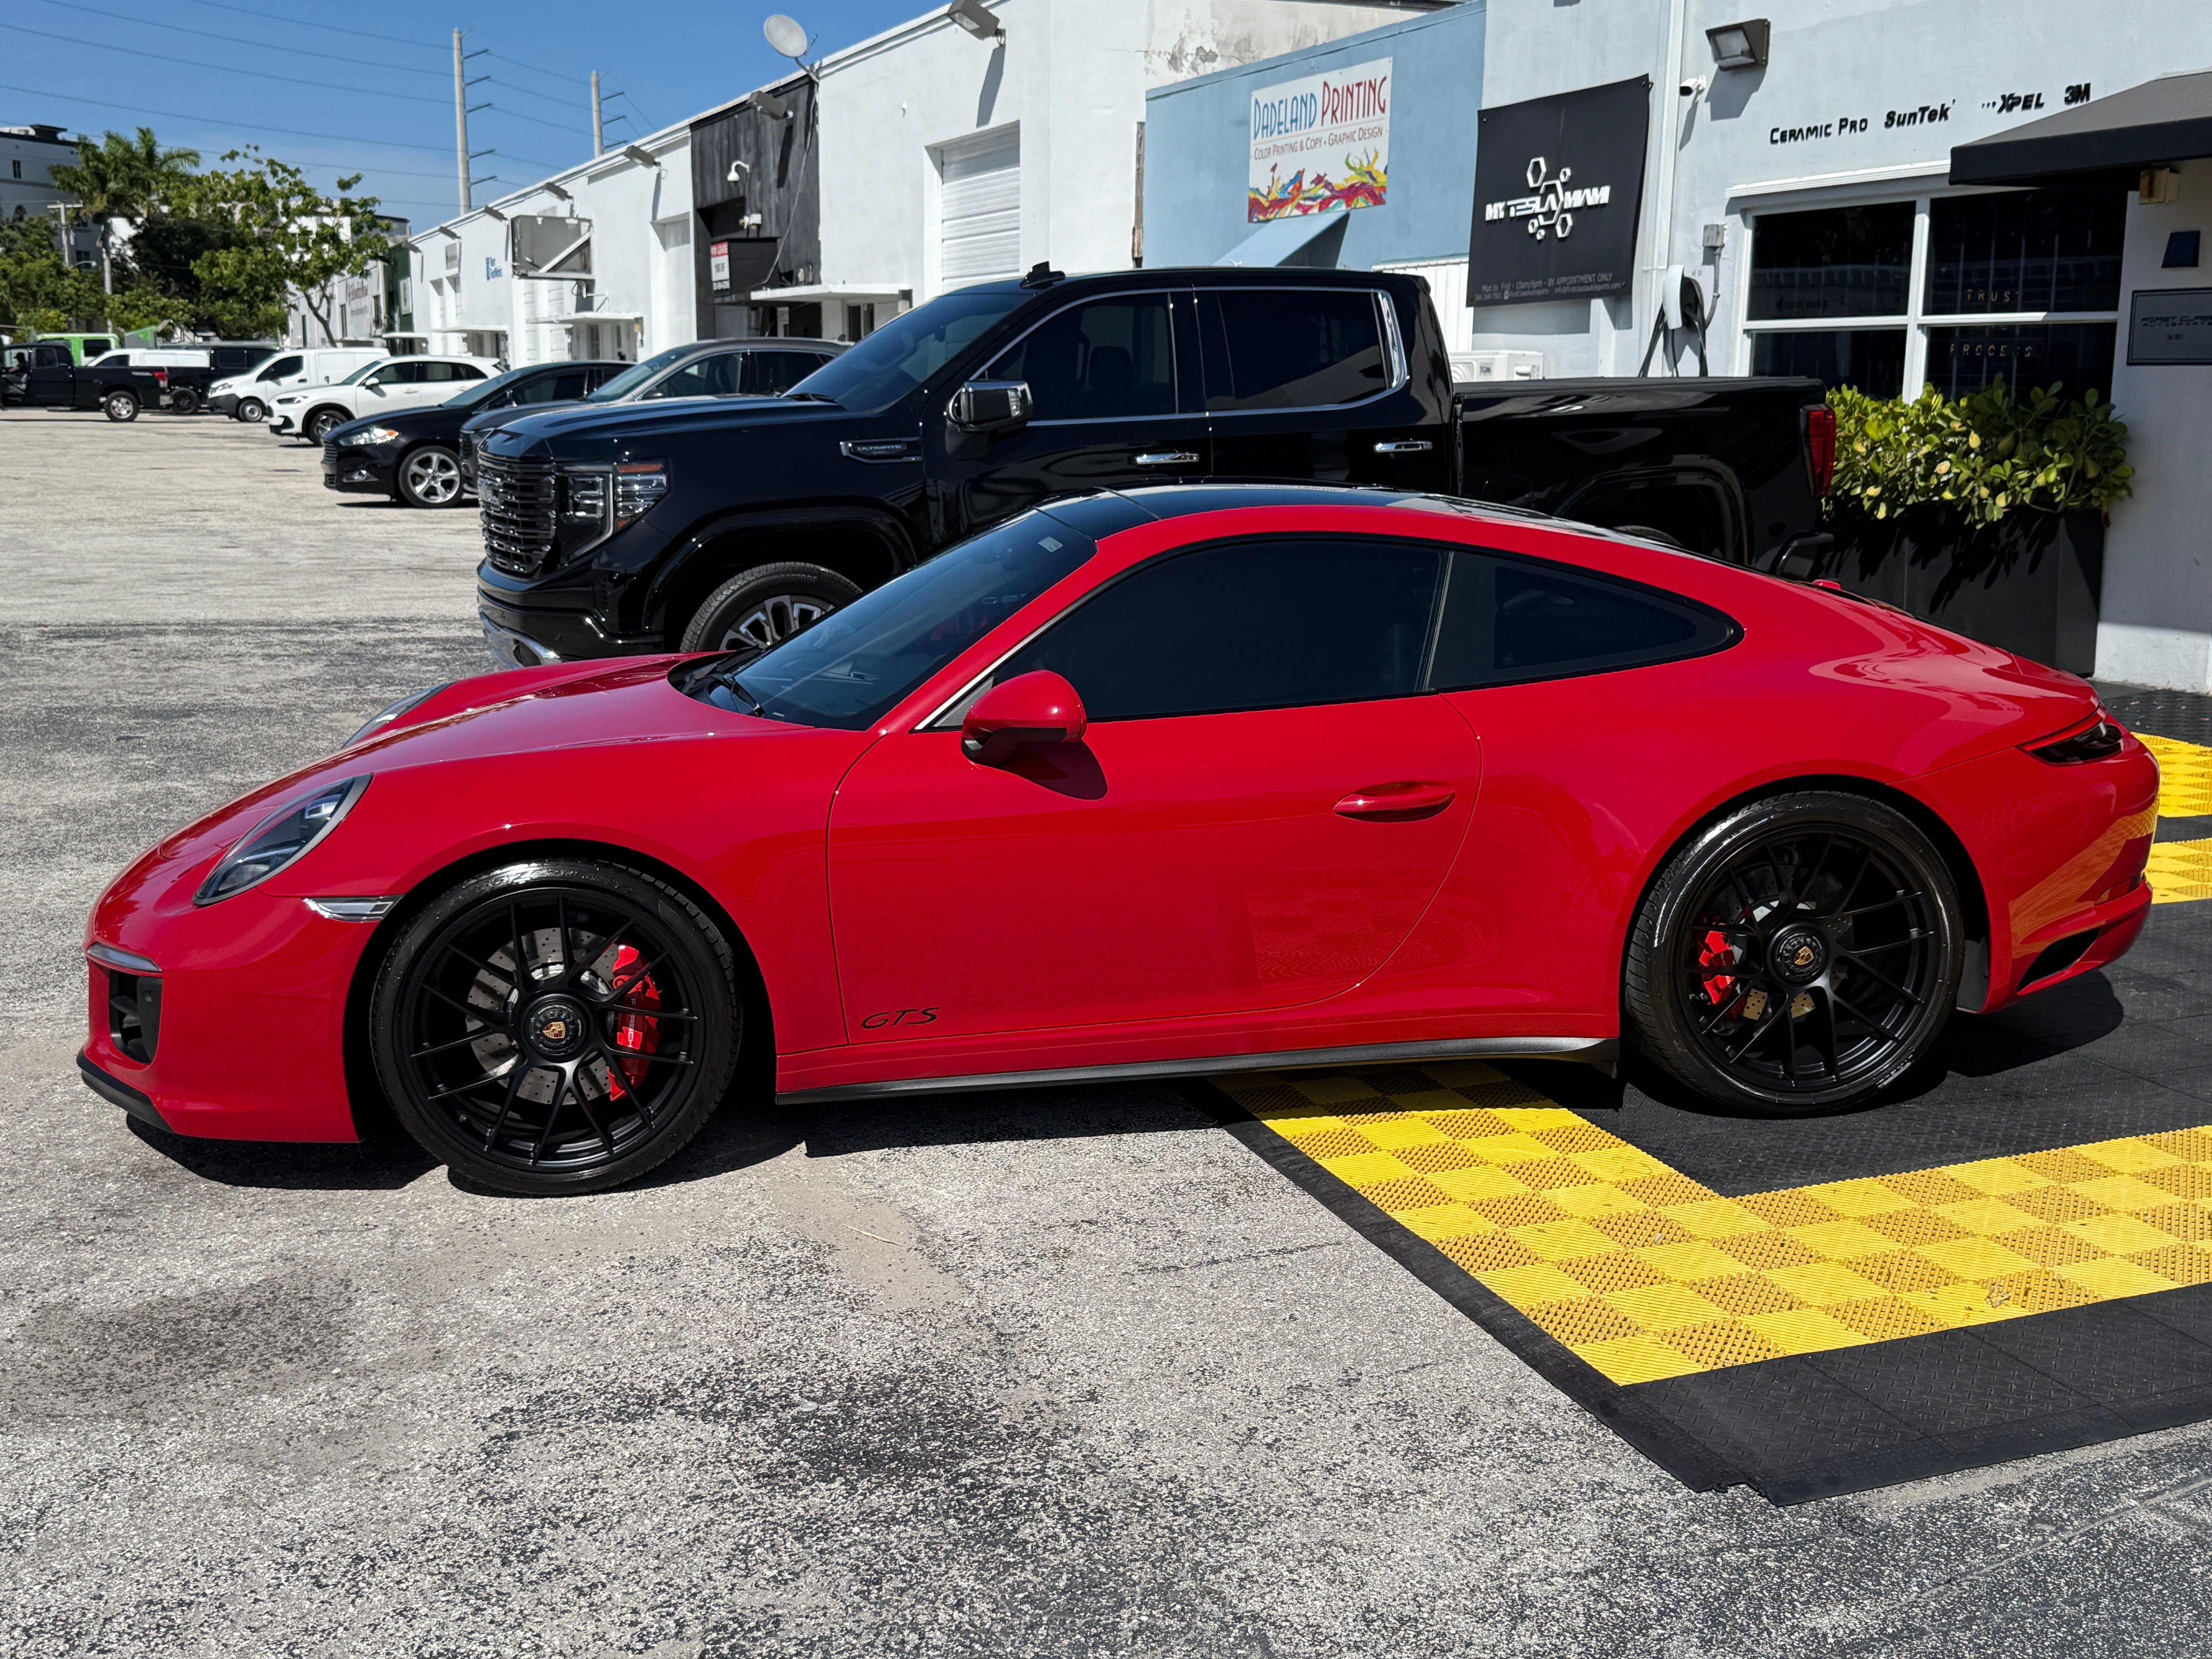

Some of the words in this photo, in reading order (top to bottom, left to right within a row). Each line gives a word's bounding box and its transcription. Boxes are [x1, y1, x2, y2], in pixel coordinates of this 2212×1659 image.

[1254, 93, 1317, 140] DADELAND
[1321, 76, 1387, 127] PRINTING
[1770, 124, 1832, 144] CERAMIC
[1838, 118, 1868, 136] PRO
[1997, 93, 2045, 114] XPEL
[2064, 82, 2091, 105] 3M
[1273, 142, 1298, 156] PRINTING
[1300, 139, 1304, 151] &
[1305, 136, 1323, 150] COPY
[1328, 130, 1357, 146] GRAPHIC
[1358, 126, 1383, 141] DESIGN
[1486, 201, 1506, 221] MY
[1507, 194, 1557, 217] TESLA
[1563, 185, 1611, 209] MIAMI
[1548, 277, 1555, 287] BY
[1556, 273, 1596, 286] APPOINTMENT
[1597, 273, 1613, 283] ONLY
[1967, 289, 2019, 302] TRUS
[861, 1007, 941, 1029] GTS
